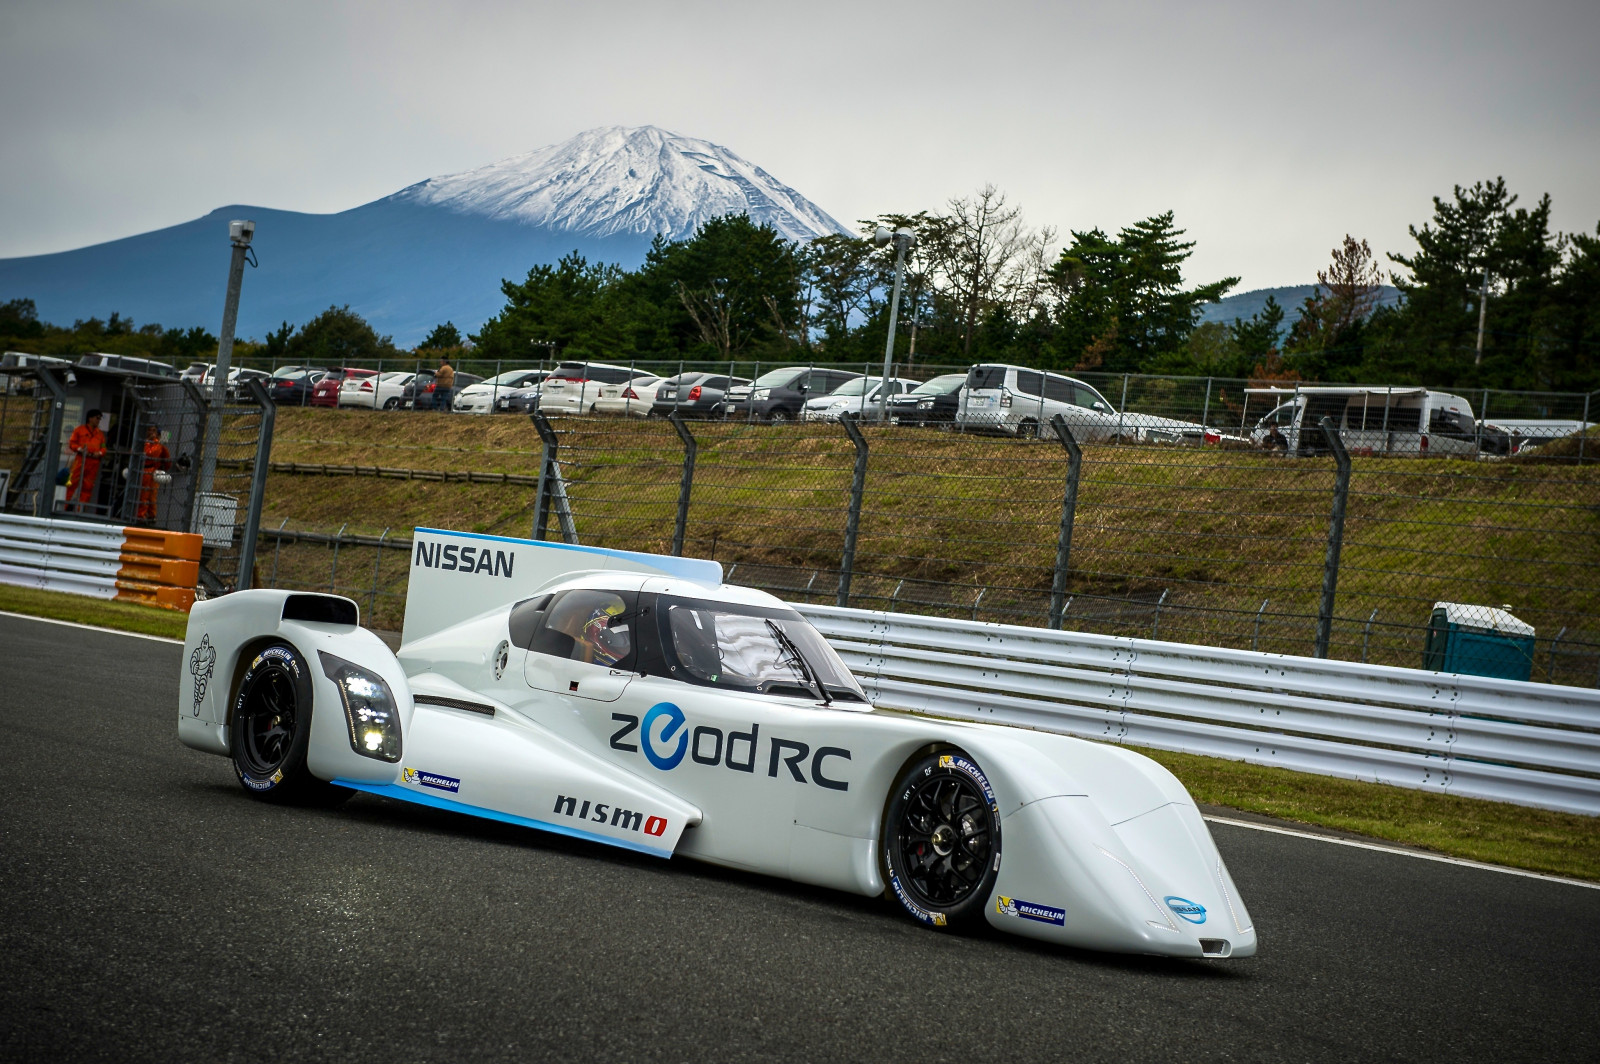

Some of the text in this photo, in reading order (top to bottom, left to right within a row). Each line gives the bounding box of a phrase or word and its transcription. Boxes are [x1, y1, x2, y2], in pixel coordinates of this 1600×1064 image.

[415, 541, 515, 578] NISSAN
[264, 648, 292, 660] MICHELIN
[609, 701, 852, 791] zeod RC
[243, 776, 271, 790] MICHELIN
[422, 775, 459, 788] MICHELIN
[956, 759, 996, 800] MICHELIN
[553, 794, 668, 837] nismo
[892, 881, 929, 921] MICHELIN
[1020, 905, 1064, 920] MICHELIN
